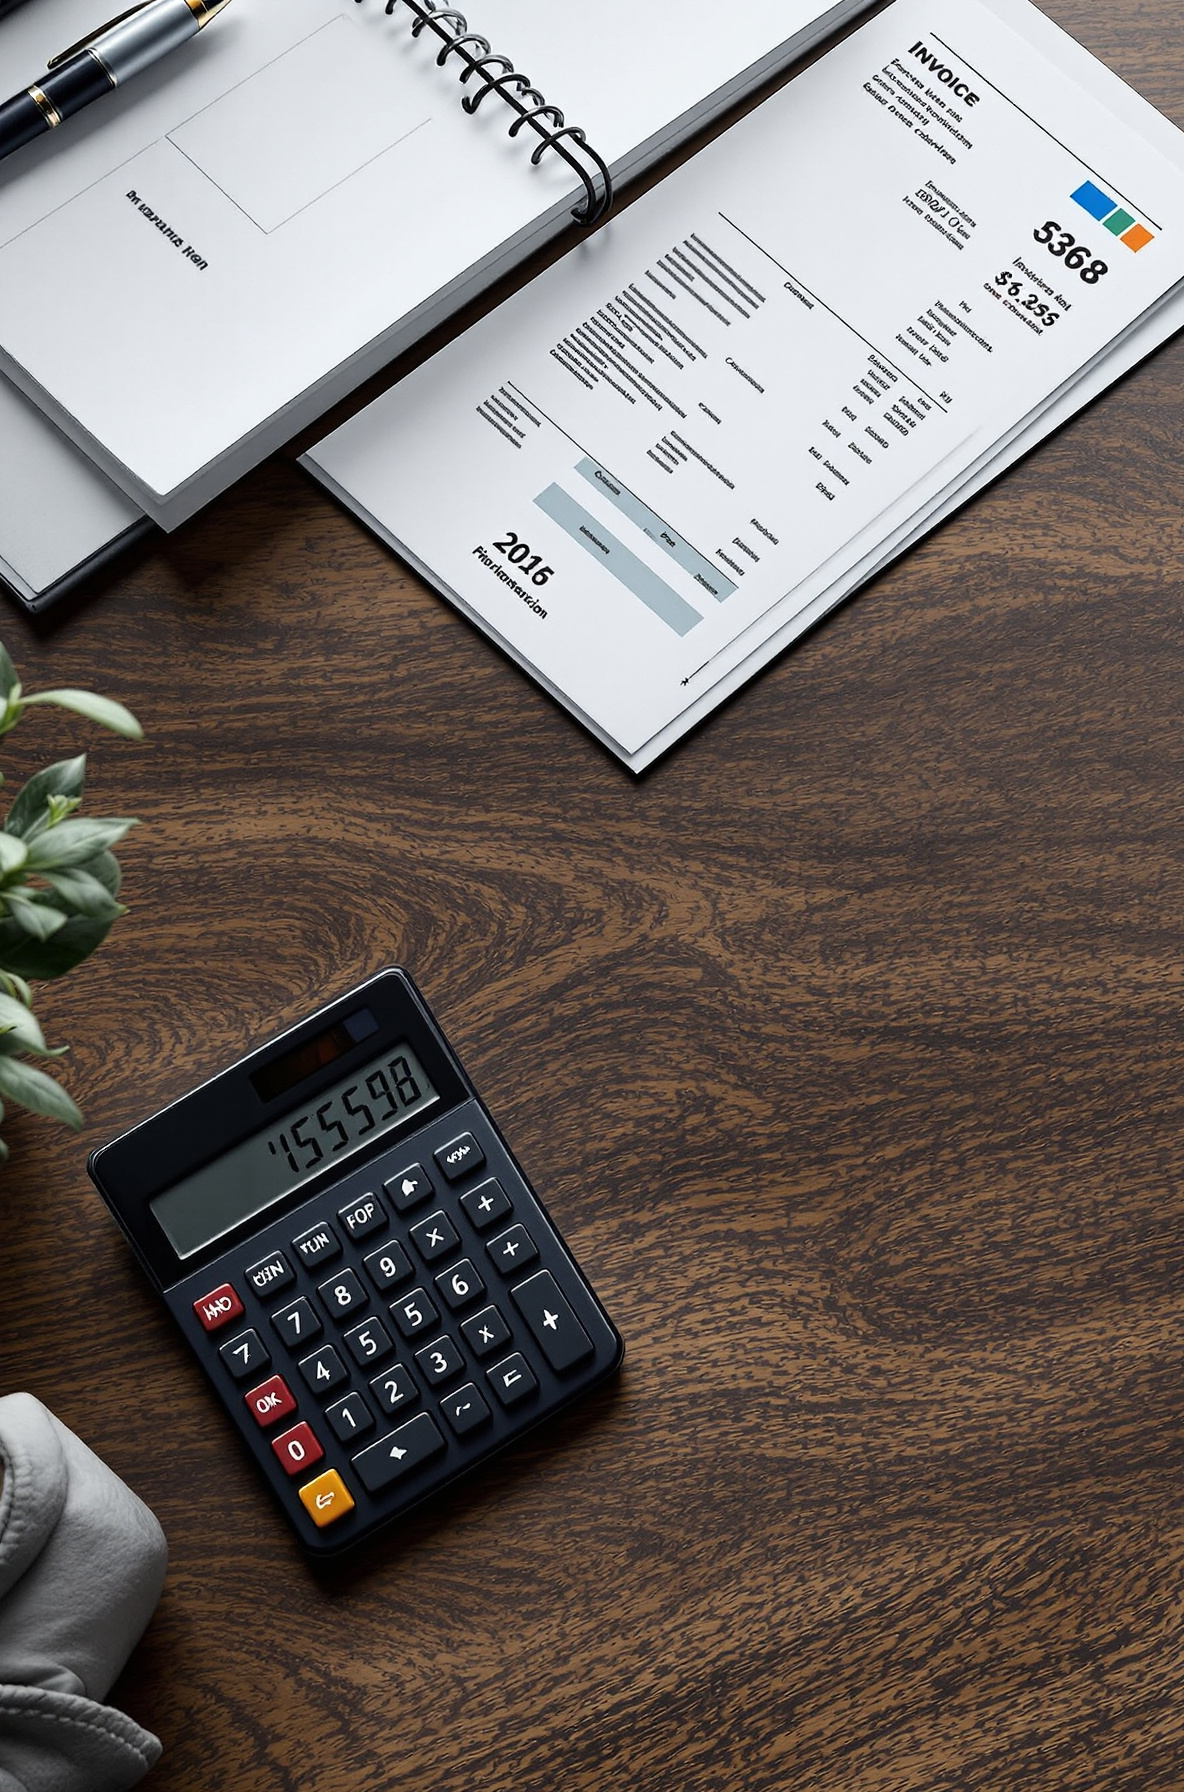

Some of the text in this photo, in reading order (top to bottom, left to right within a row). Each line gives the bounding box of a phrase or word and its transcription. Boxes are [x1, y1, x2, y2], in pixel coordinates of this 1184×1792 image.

[908, 41, 980, 107] INVOICE
[1034, 221, 1108, 284] 5368
[493, 532, 554, 585] 2016
[380, 1258, 395, 1277] 9
[452, 1274, 468, 1295] 6
[335, 1286, 351, 1305] 8
[288, 1312, 300, 1333] 7
[404, 1302, 422, 1326] 5
[359, 1331, 376, 1355] 5
[317, 1361, 330, 1380] 4
[430, 1353, 447, 1372] 3
[385, 1381, 403, 1403] 2
[343, 1408, 356, 1427] 1
[288, 1441, 304, 1460] 0
